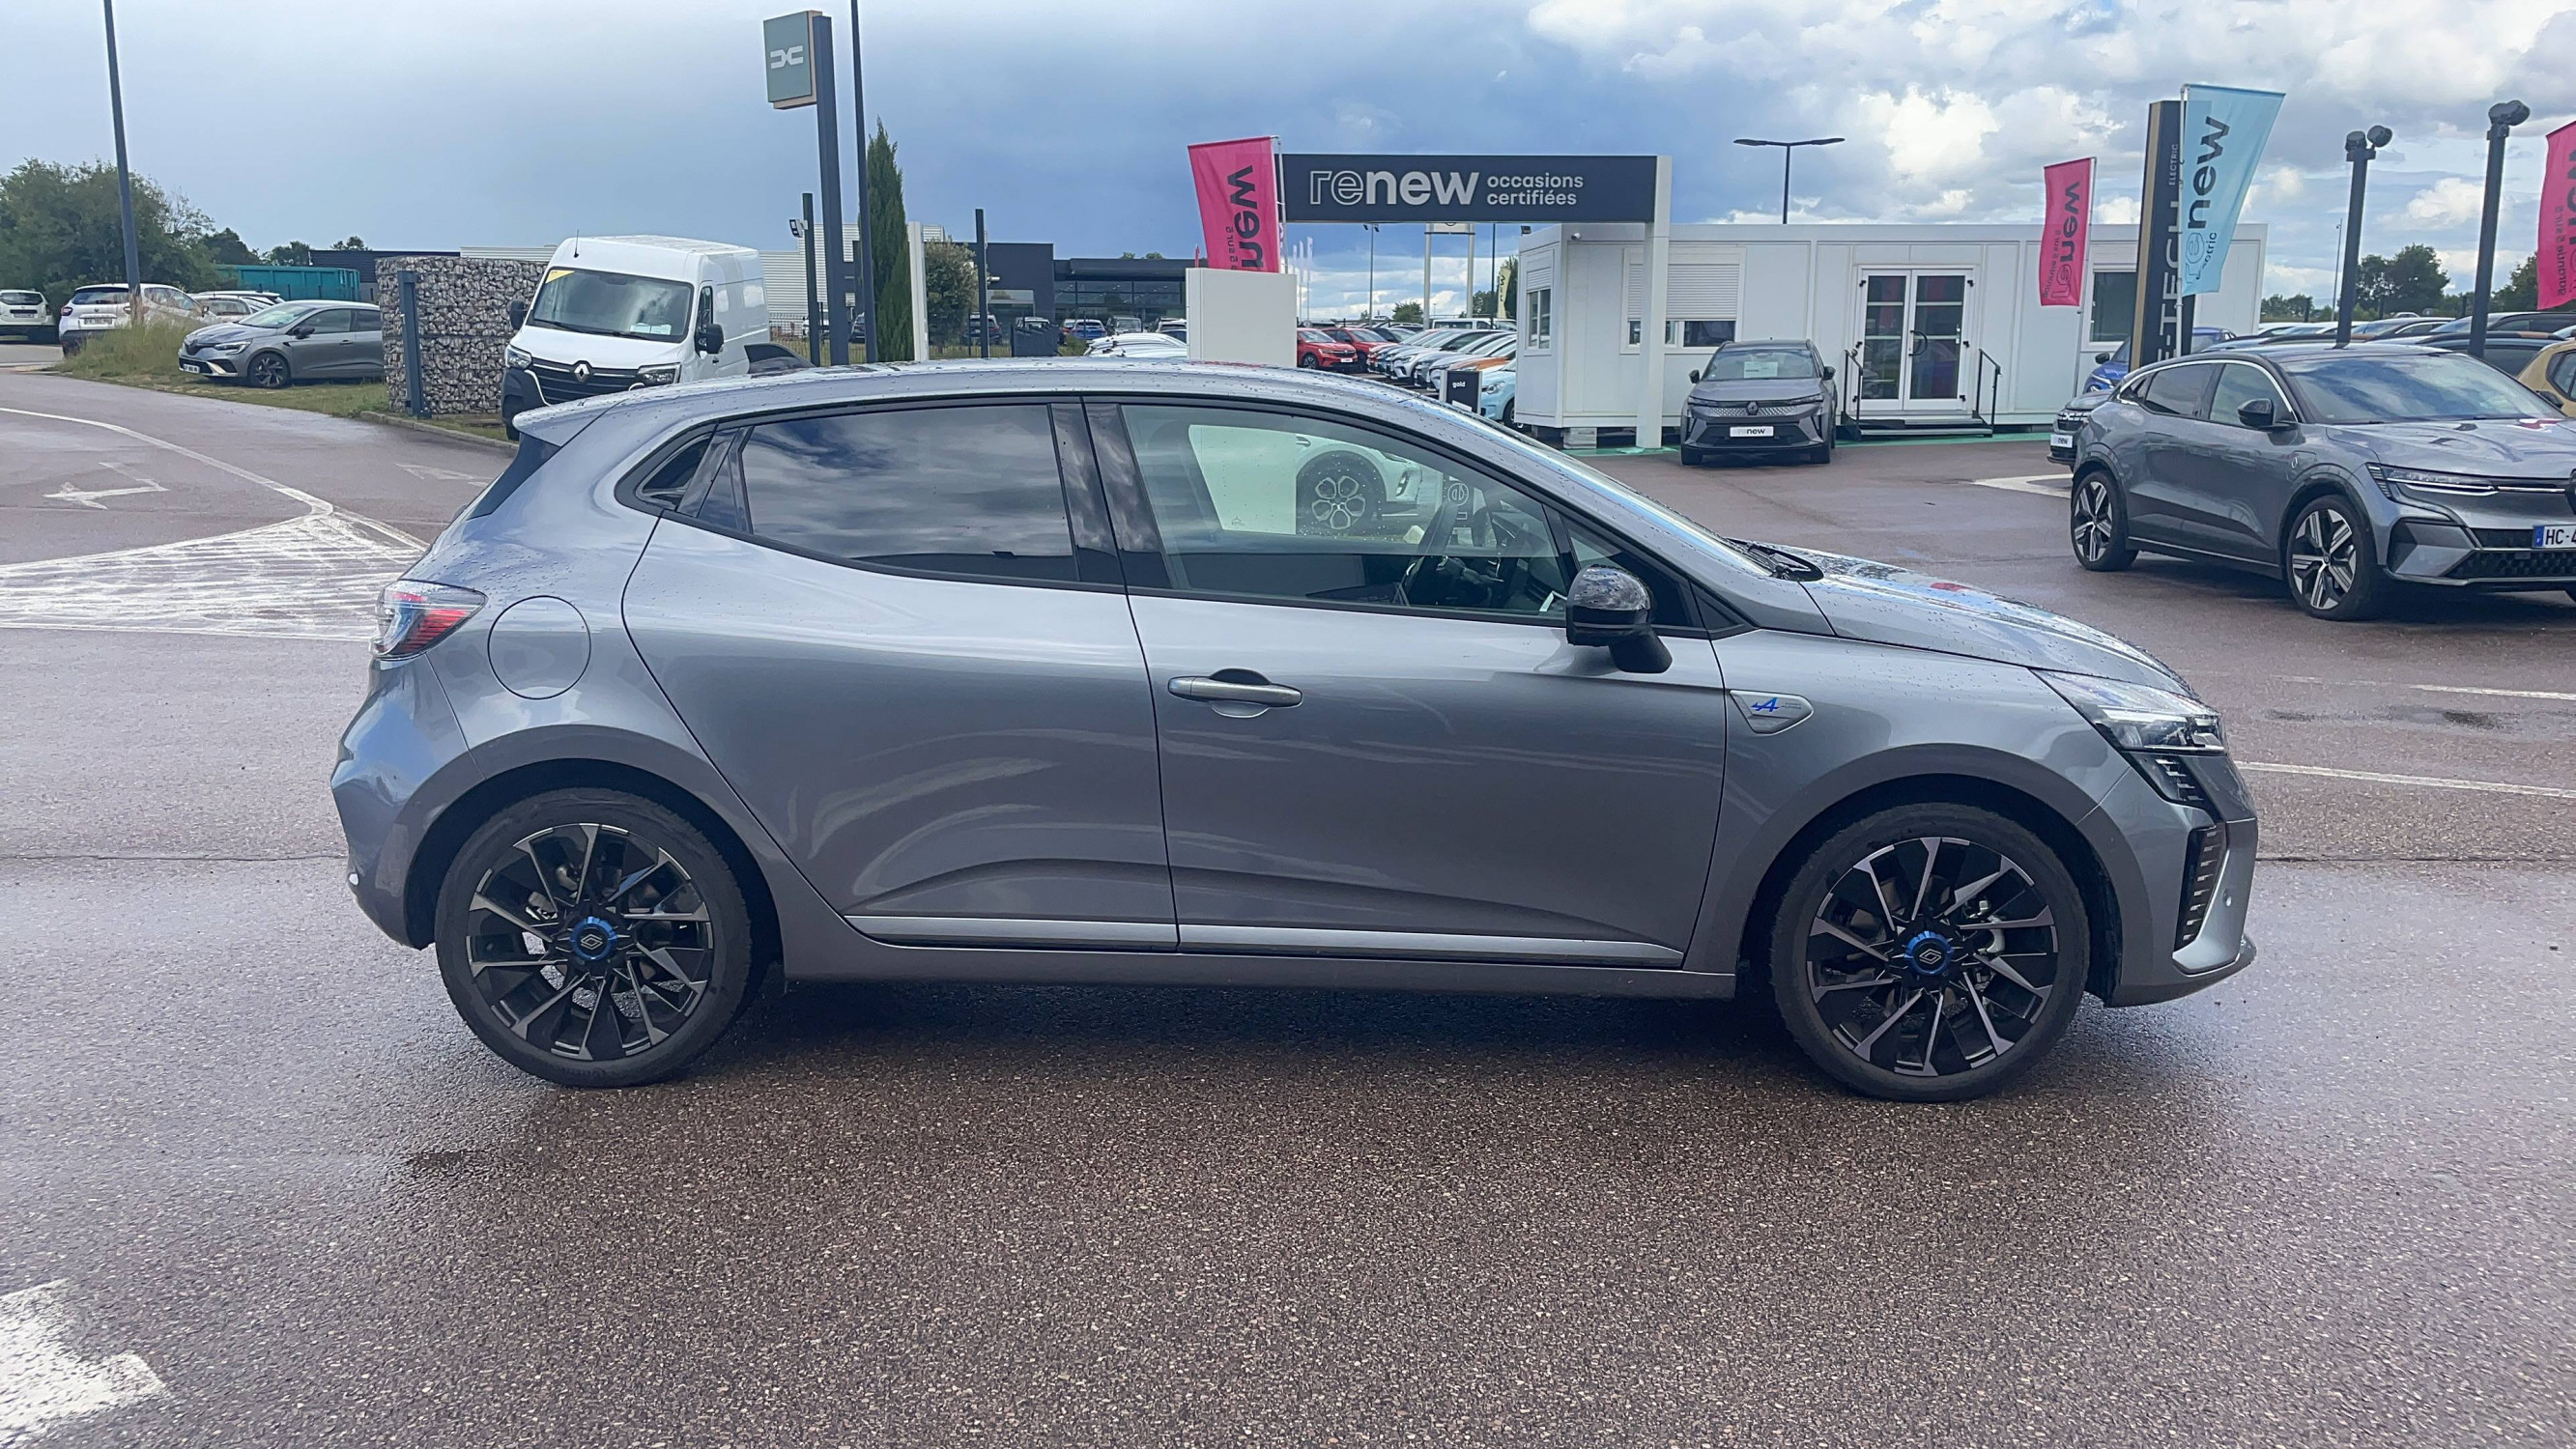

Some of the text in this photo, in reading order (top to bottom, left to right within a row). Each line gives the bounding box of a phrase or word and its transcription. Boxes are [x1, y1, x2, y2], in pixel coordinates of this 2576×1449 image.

[1487, 172, 1585, 188] occasions
[2168, 144, 2178, 185] ELECTRIC
[1310, 170, 1480, 206] renew
[1487, 189, 1577, 206] certifiées
[2185, 116, 2230, 284] renew
